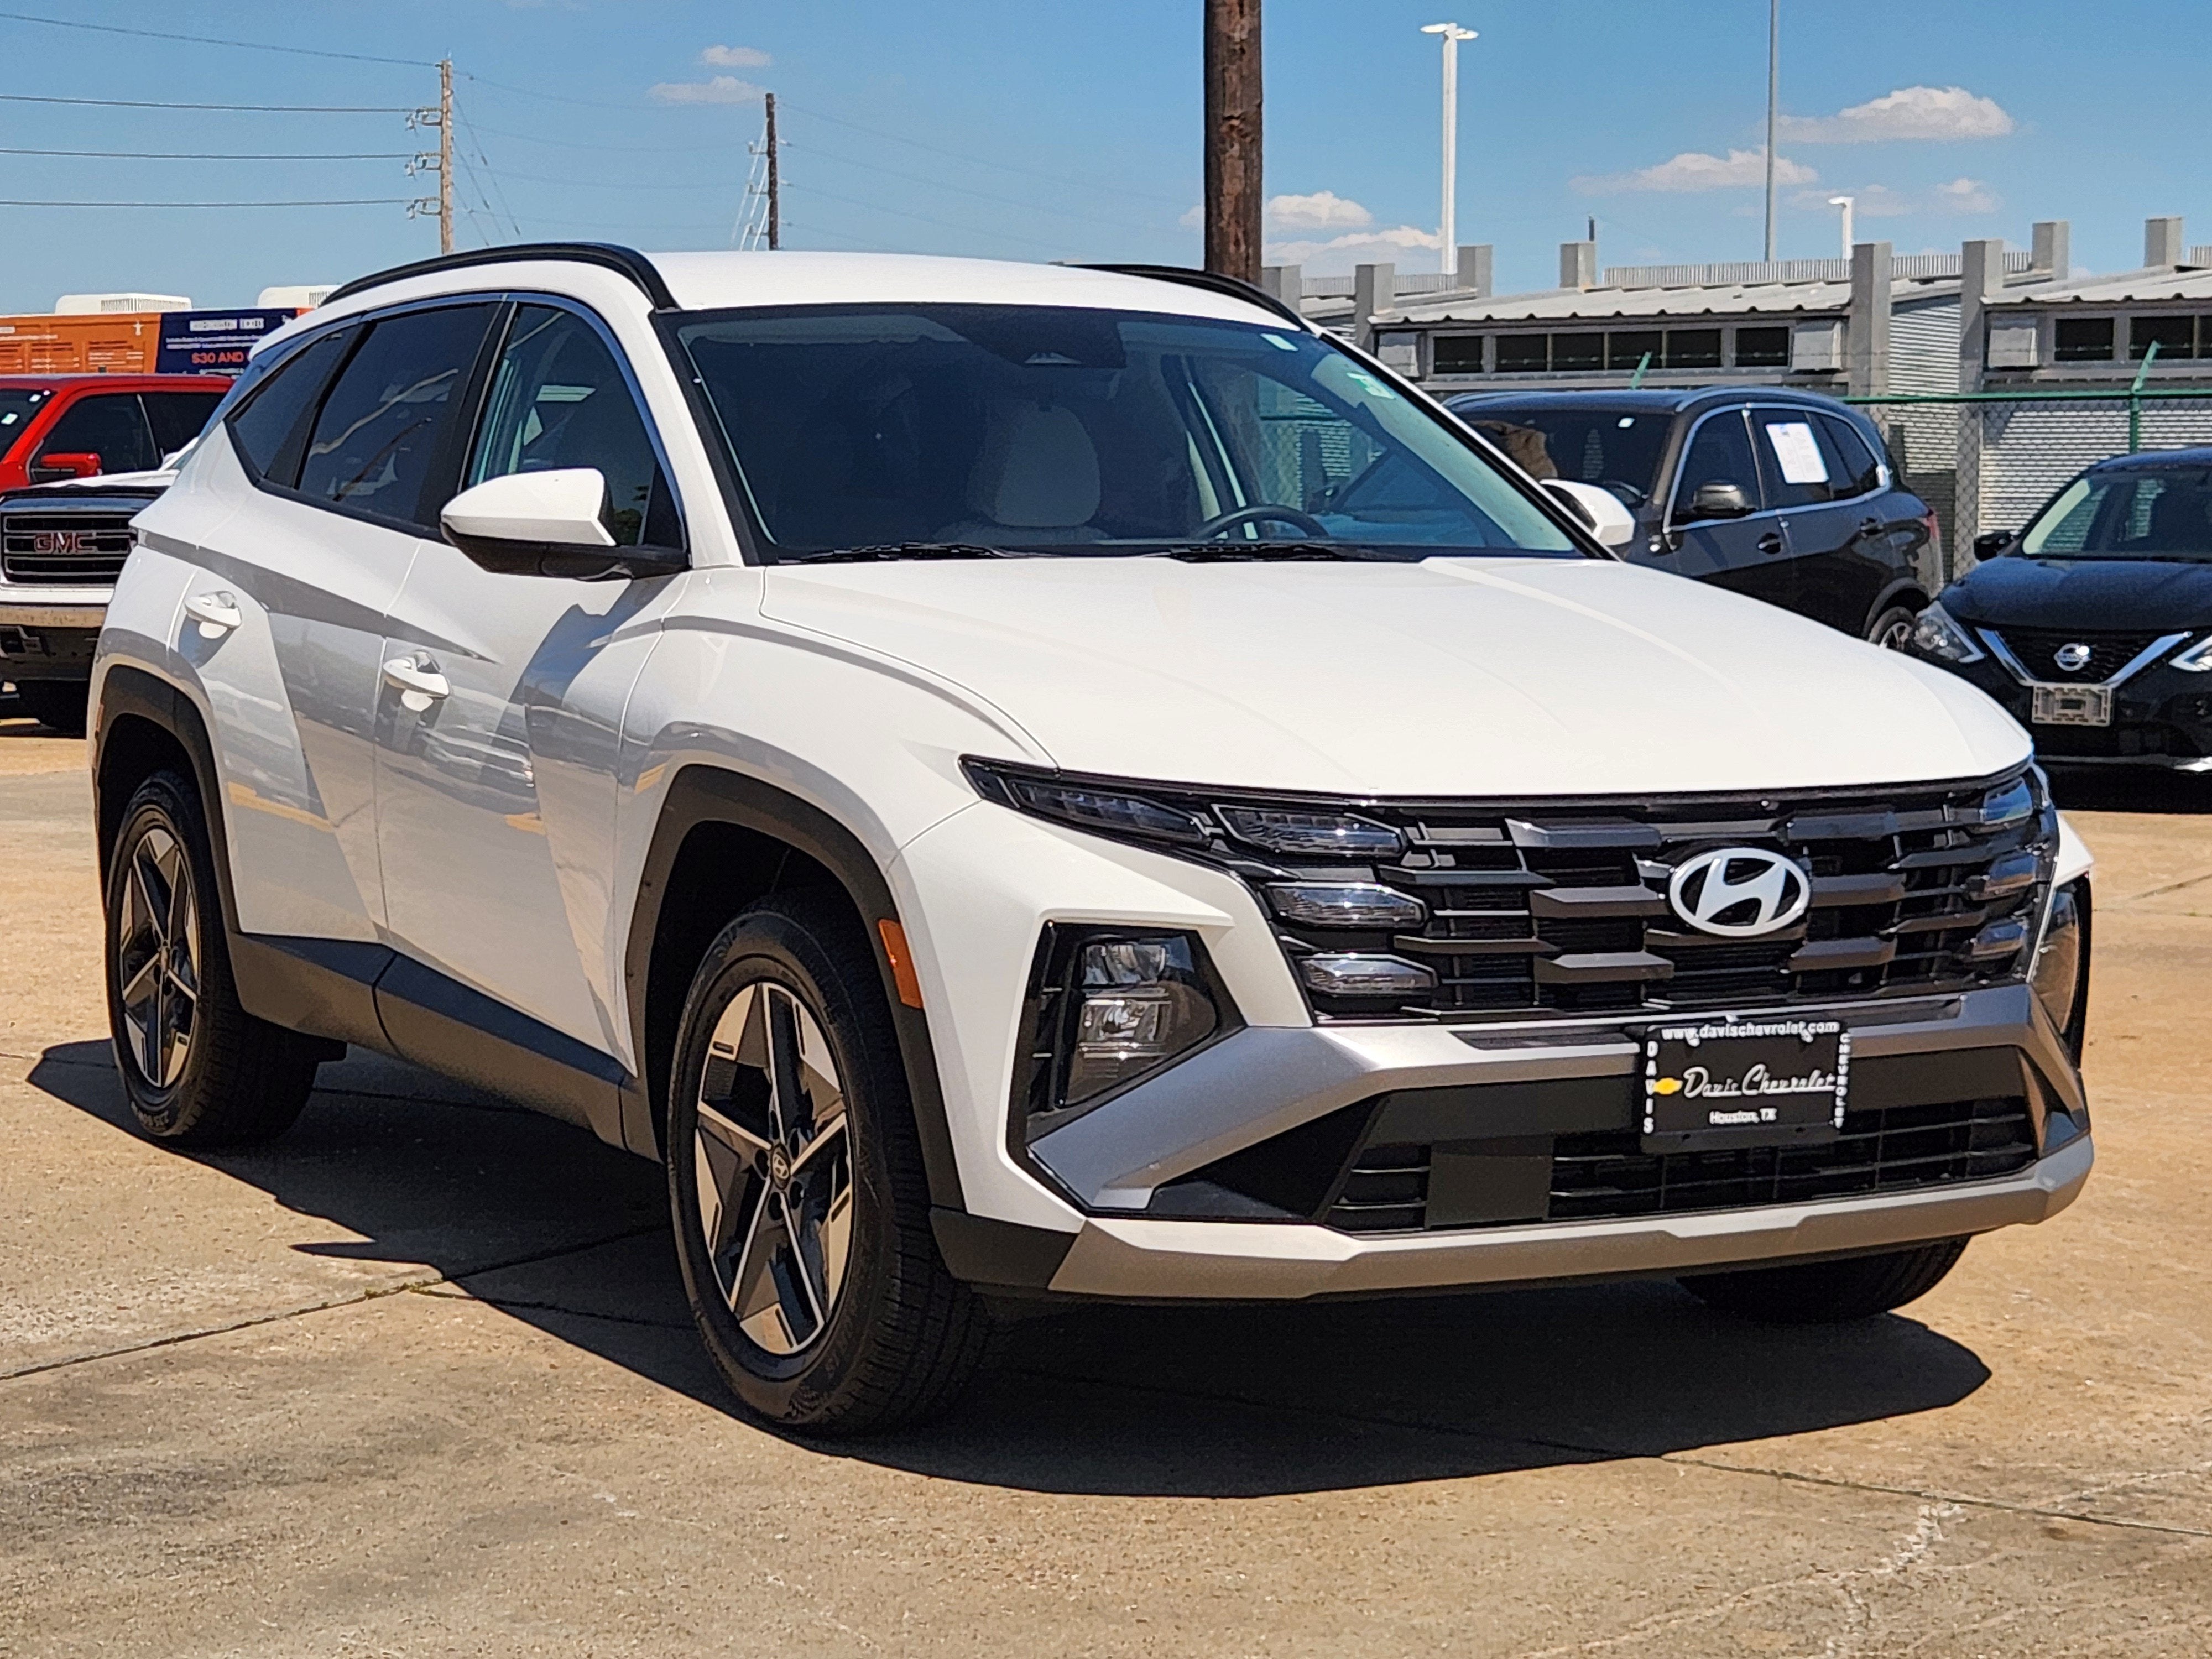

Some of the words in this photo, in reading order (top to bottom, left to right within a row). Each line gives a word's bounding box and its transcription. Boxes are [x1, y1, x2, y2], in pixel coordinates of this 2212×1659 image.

[218, 351, 244, 363] AND
[35, 532, 97, 554] GMC
[1661, 1021, 1840, 1040] www.davischevrolet.com
[1643, 1041, 1658, 1134] DAVIS
[1683, 1066, 1742, 1098] Davis
[1742, 1063, 1835, 1095] Chevrolet
[1759, 1108, 1777, 1121] TX
